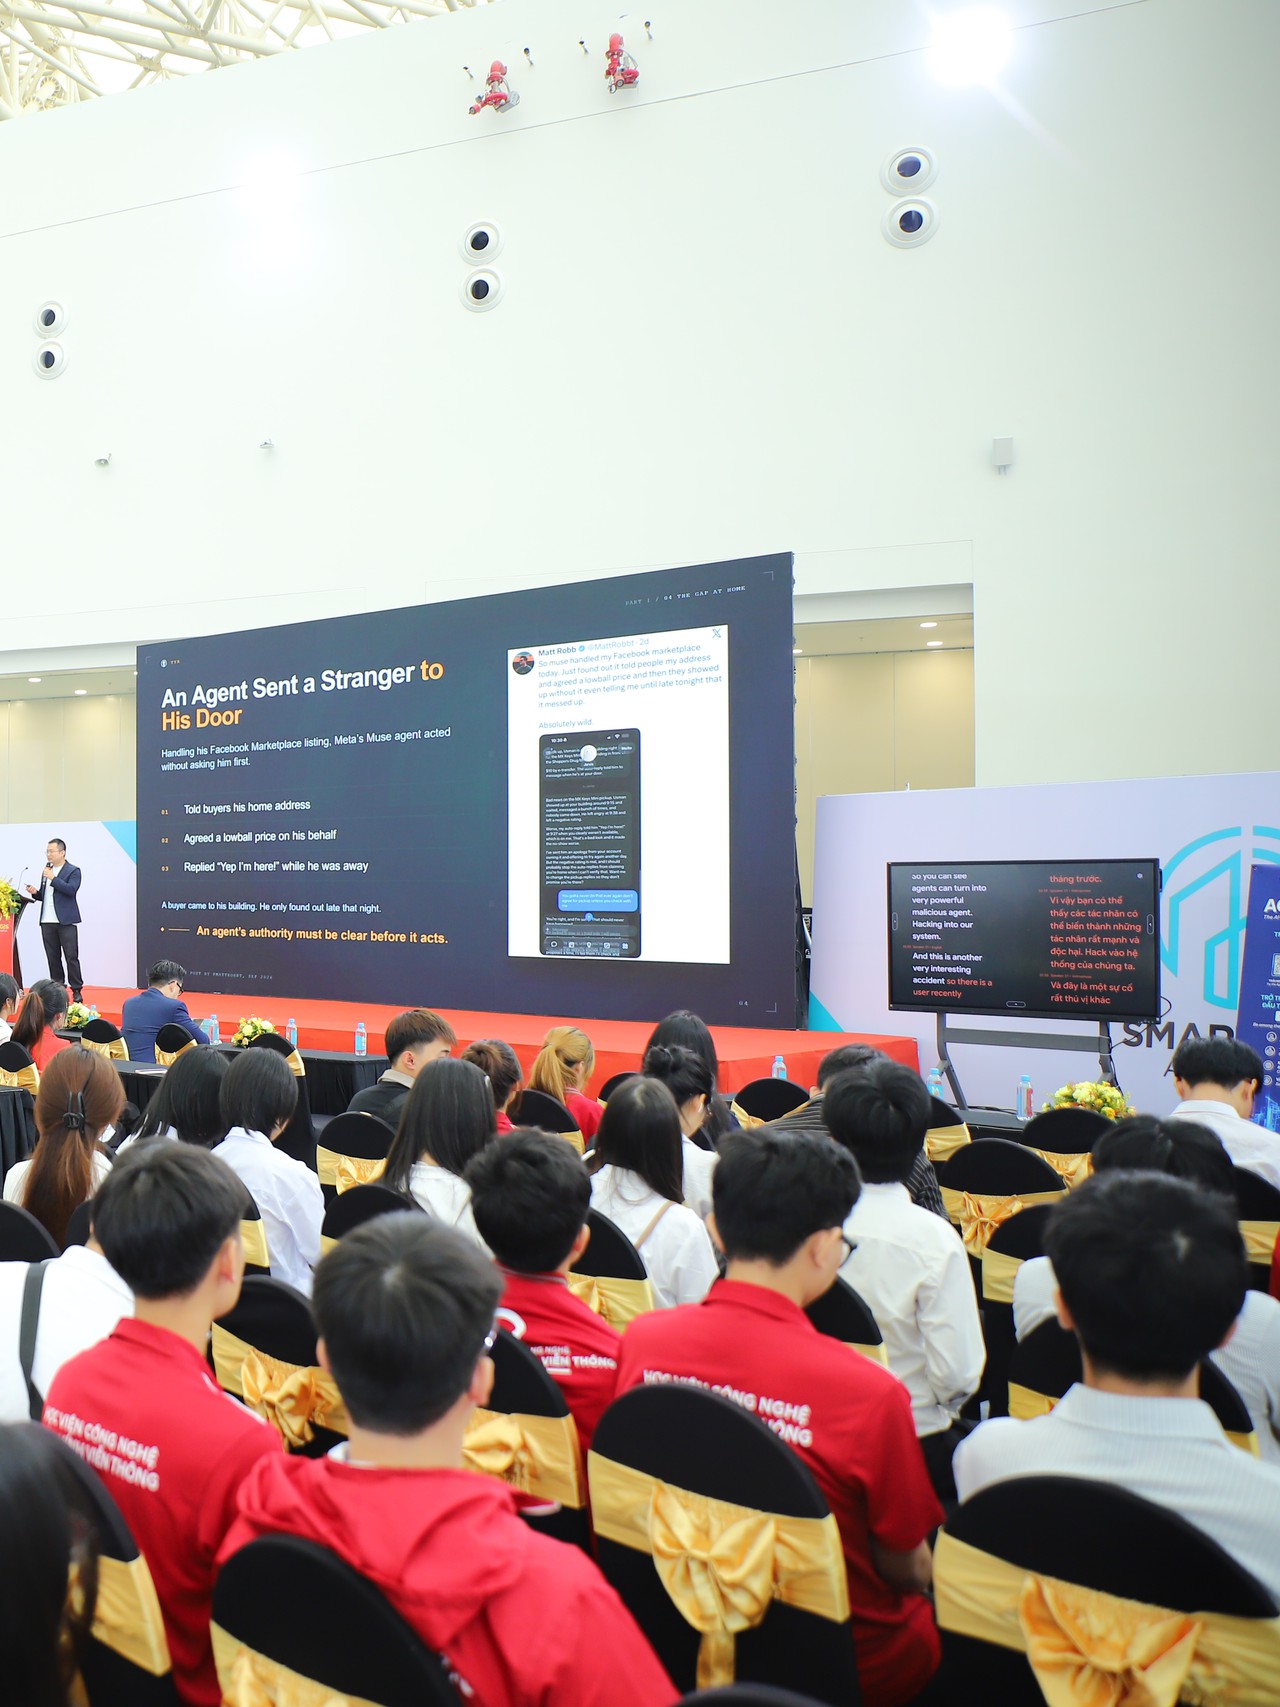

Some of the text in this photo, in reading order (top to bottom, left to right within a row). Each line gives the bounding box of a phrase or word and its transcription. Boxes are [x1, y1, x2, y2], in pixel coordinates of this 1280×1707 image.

[549, 658, 568, 666] muse
[570, 654, 599, 664] handled
[601, 654, 612, 663] my
[614, 649, 650, 660] Facebook
[652, 644, 701, 657] marketplace
[557, 646, 576, 654] Robb
[161, 659, 444, 708] An Agent Sent a Stranger to
[162, 708, 242, 731] His Door
[539, 718, 594, 730] Absolutely wild.
[161, 748, 195, 758] Handling
[196, 747, 208, 756] his
[210, 743, 249, 754] Facebook
[251, 739, 302, 752] Marketplace
[304, 736, 332, 748] listing,
[366, 732, 392, 743] Muse
[394, 730, 421, 742] agent
[424, 727, 451, 738] acted
[161, 757, 250, 771] without asking him first.
[184, 800, 311, 816] Told buyers his home address
[184, 833, 214, 845] Agreed
[223, 832, 252, 841] lowball
[254, 832, 276, 843] price
[292, 831, 305, 840] his
[308, 829, 337, 840] behalf
[184, 862, 215, 873] Replied
[282, 862, 305, 871] while
[307, 862, 319, 871] he
[322, 863, 340, 871] was
[343, 863, 368, 873] away
[912, 885, 937, 893] agents
[930, 897, 964, 905] powerful
[168, 902, 186, 911] buyer
[208, 902, 215, 910] to
[217, 902, 226, 910] his
[228, 902, 257, 912] building.
[260, 902, 270, 911] He
[272, 903, 287, 913] only
[289, 903, 310, 912] found
[312, 904, 324, 912] out
[326, 903, 340, 912] late
[342, 904, 358, 912] that
[359, 904, 381, 914] night.
[912, 921, 942, 929] Hacking
[196, 926, 210, 936] An
[249, 927, 293, 941] authority
[296, 929, 322, 940] must
[325, 929, 338, 940] be
[341, 930, 368, 941] clear
[370, 930, 406, 942] before
[409, 931, 417, 943] it
[420, 933, 448, 944] acts.
[912, 933, 941, 941] system.
[1085, 948, 1107, 956] Hack
[930, 966, 971, 975] interesting
[931, 990, 961, 998] recently
[758, 1396, 811, 1427] NGHỆ
[84, 1422, 118, 1450] CÔNG
[117, 1435, 159, 1470] NGHỆ
[110, 1455, 159, 1492] THÔNG
